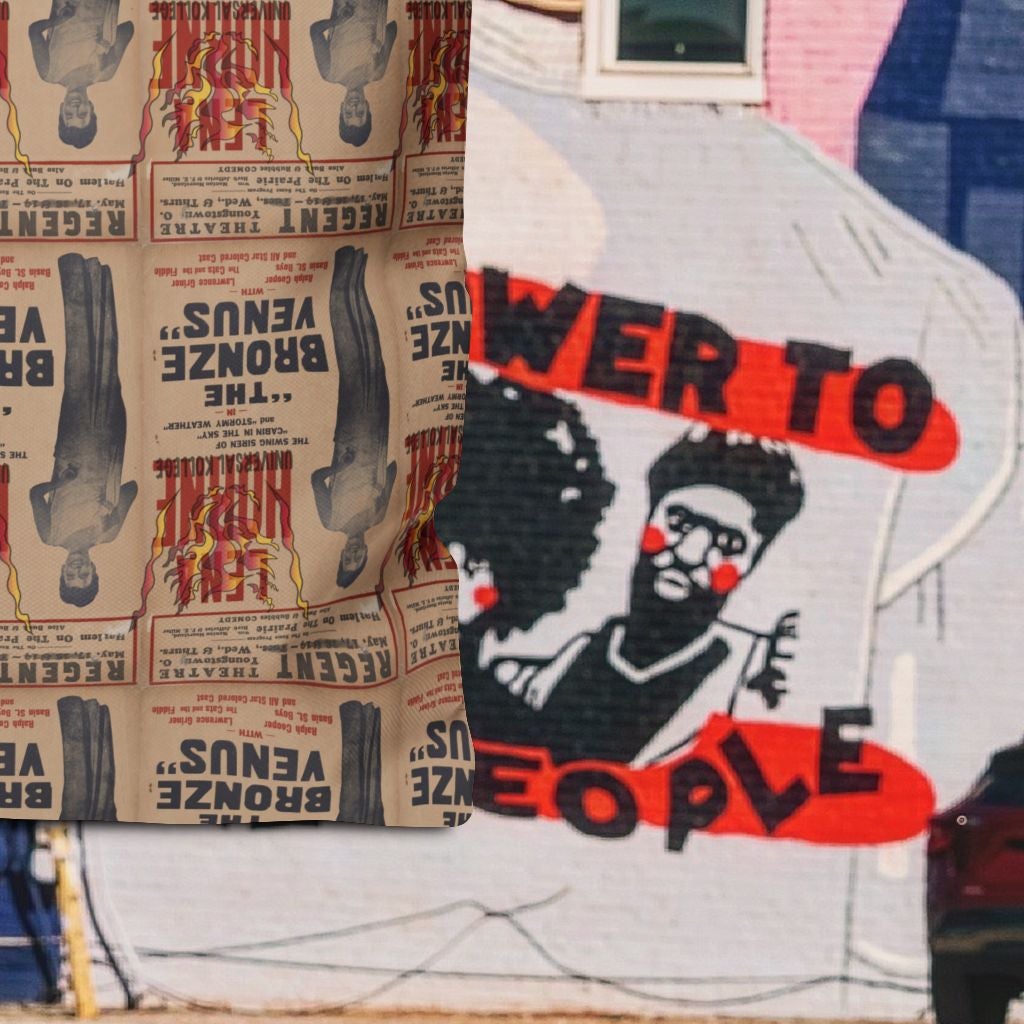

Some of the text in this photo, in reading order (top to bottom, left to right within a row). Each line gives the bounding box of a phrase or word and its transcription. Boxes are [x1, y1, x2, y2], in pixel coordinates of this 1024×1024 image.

[151, 0, 291, 21] UNIVERSAL KOLLEGE
[27, 178, 49, 187] The
[56, 178, 73, 187] On
[160, 203, 388, 235] REGENT THEATRE
[1, 256, 14, 264] and
[15, 268, 25, 277] St.
[13, 281, 34, 290] Ralph
[241, 288, 264, 296] WITH
[406, 281, 466, 320] US”
[159, 297, 315, 340] VENUS”
[411, 321, 470, 362] NZE
[161, 334, 328, 381] BRONZE
[479, 267, 935, 455] WER TO
[204, 381, 292, 407] “THE
[10, 450, 27, 459] THE
[155, 449, 293, 479] UNIVERSAL KOLLEGE
[159, 650, 391, 684] REGENT THEATRE
[239, 729, 263, 739] WITH
[264, 720, 317, 736] Ralph Cooper
[409, 720, 471, 762] US”
[156, 739, 325, 782] VENUS”
[411, 766, 474, 807] NZE
[472, 707, 881, 852] EOPLE
[156, 780, 331, 813] BRONZE
